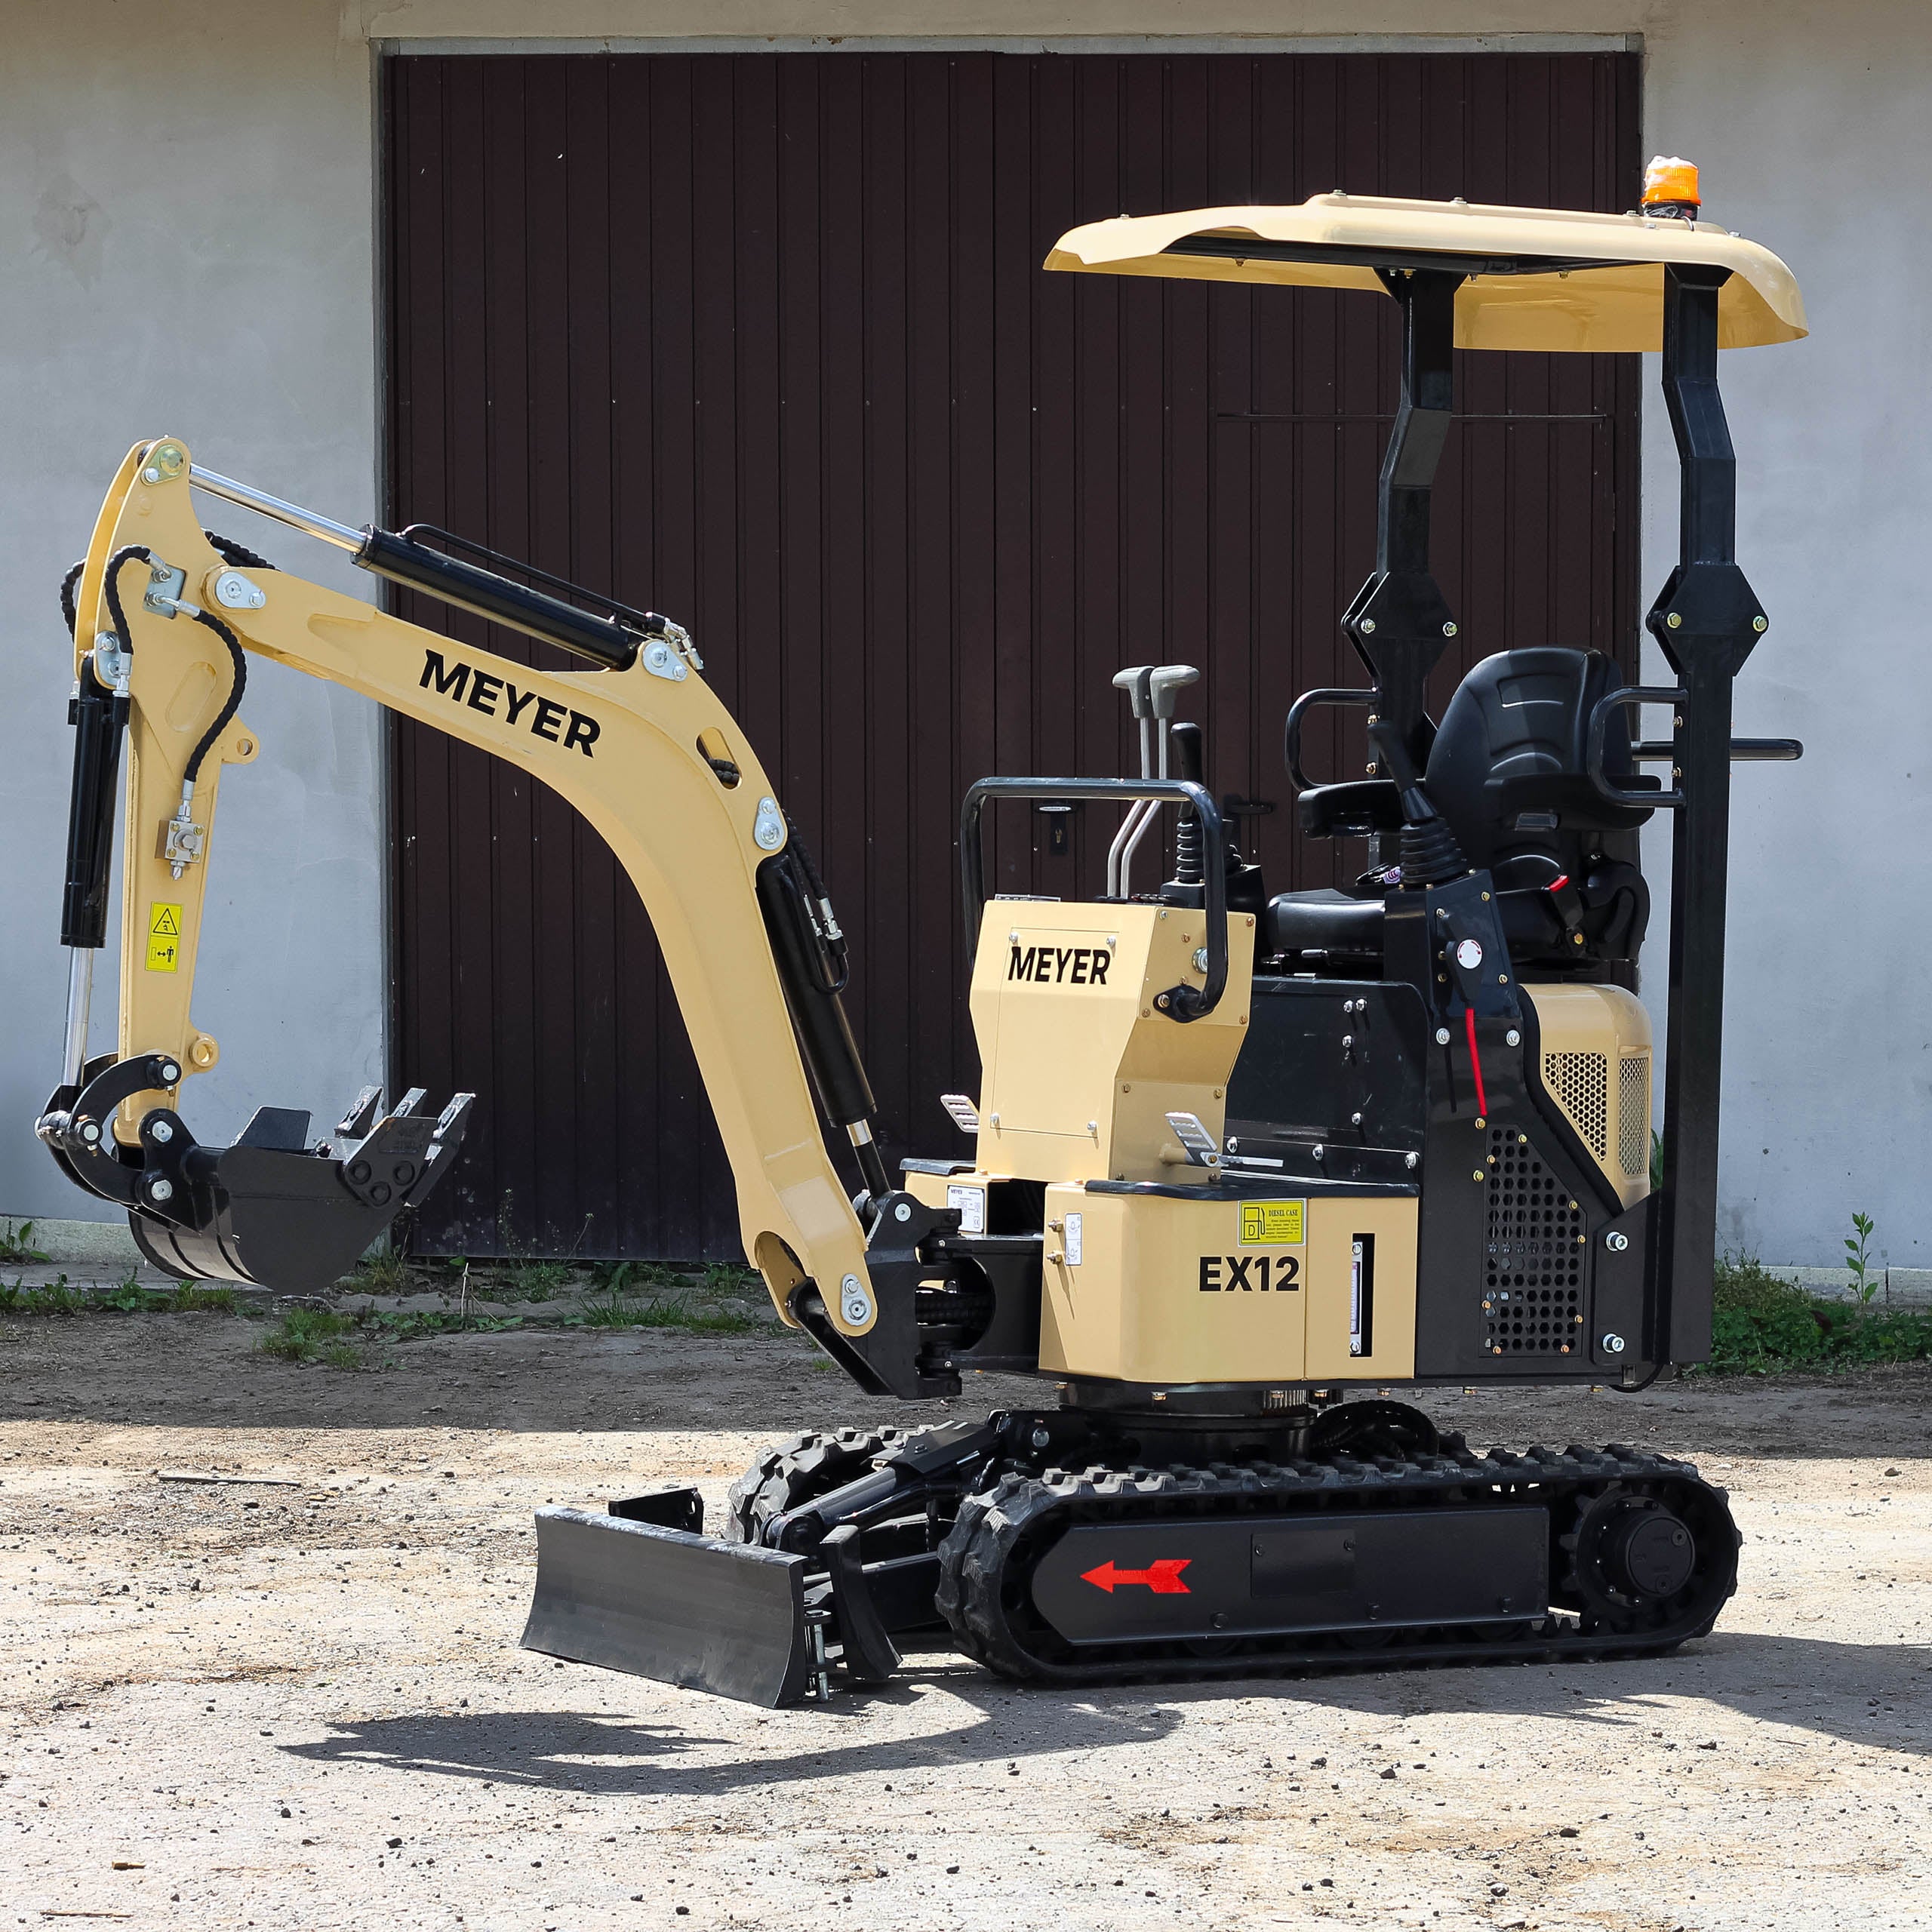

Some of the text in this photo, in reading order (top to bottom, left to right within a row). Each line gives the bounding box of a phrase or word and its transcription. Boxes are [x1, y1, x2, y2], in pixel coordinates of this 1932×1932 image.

[419, 649, 601, 758] MEYER
[1008, 946, 1111, 985] MEYER
[1248, 1224, 1255, 1236] D
[1199, 1256, 1300, 1292] EX12
